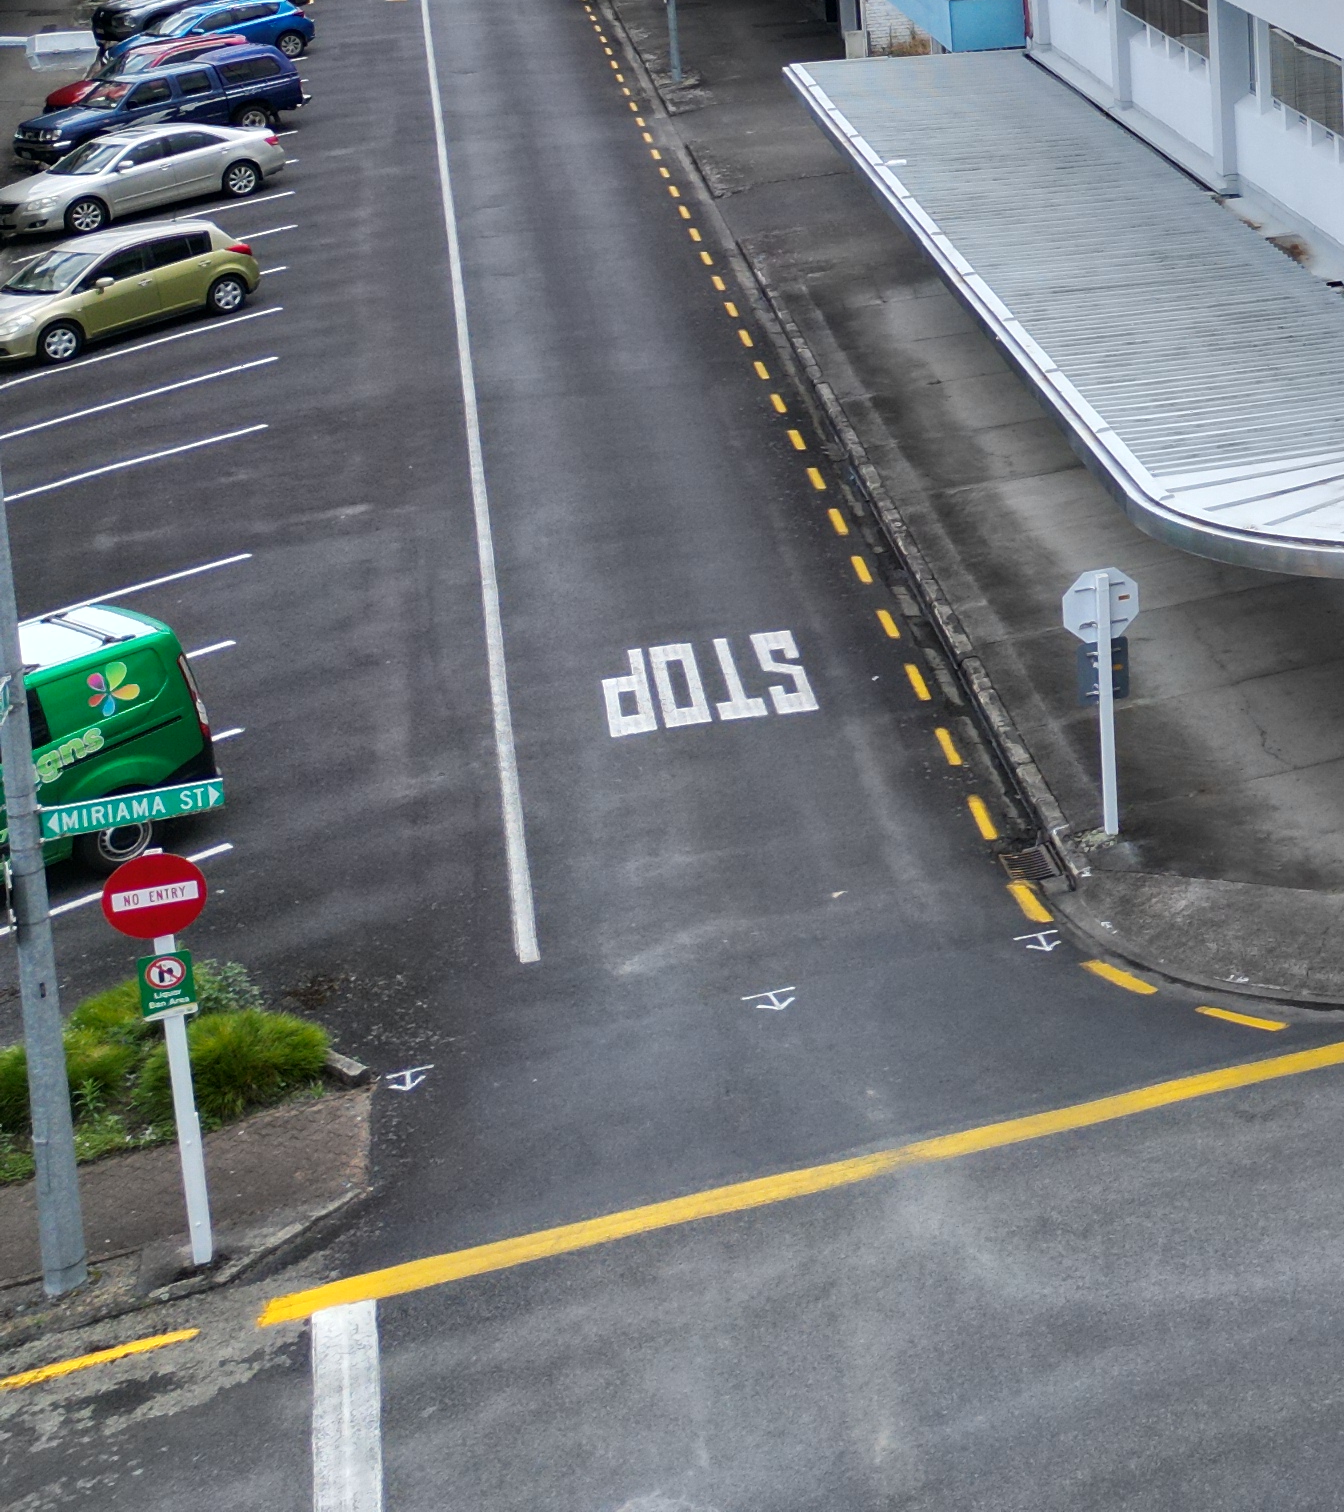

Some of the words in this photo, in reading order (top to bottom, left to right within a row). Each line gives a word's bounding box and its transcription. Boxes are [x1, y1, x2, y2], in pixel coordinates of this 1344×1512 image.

[602, 630, 820, 738] STOP
[61, 795, 167, 832] MIRIAMA
[179, 787, 205, 810] ST
[123, 893, 139, 907] NO
[149, 885, 186, 903] ENTRY
[148, 1000, 167, 1009] Ban
[169, 996, 190, 1007] Area
[153, 989, 182, 1000] Liquor
